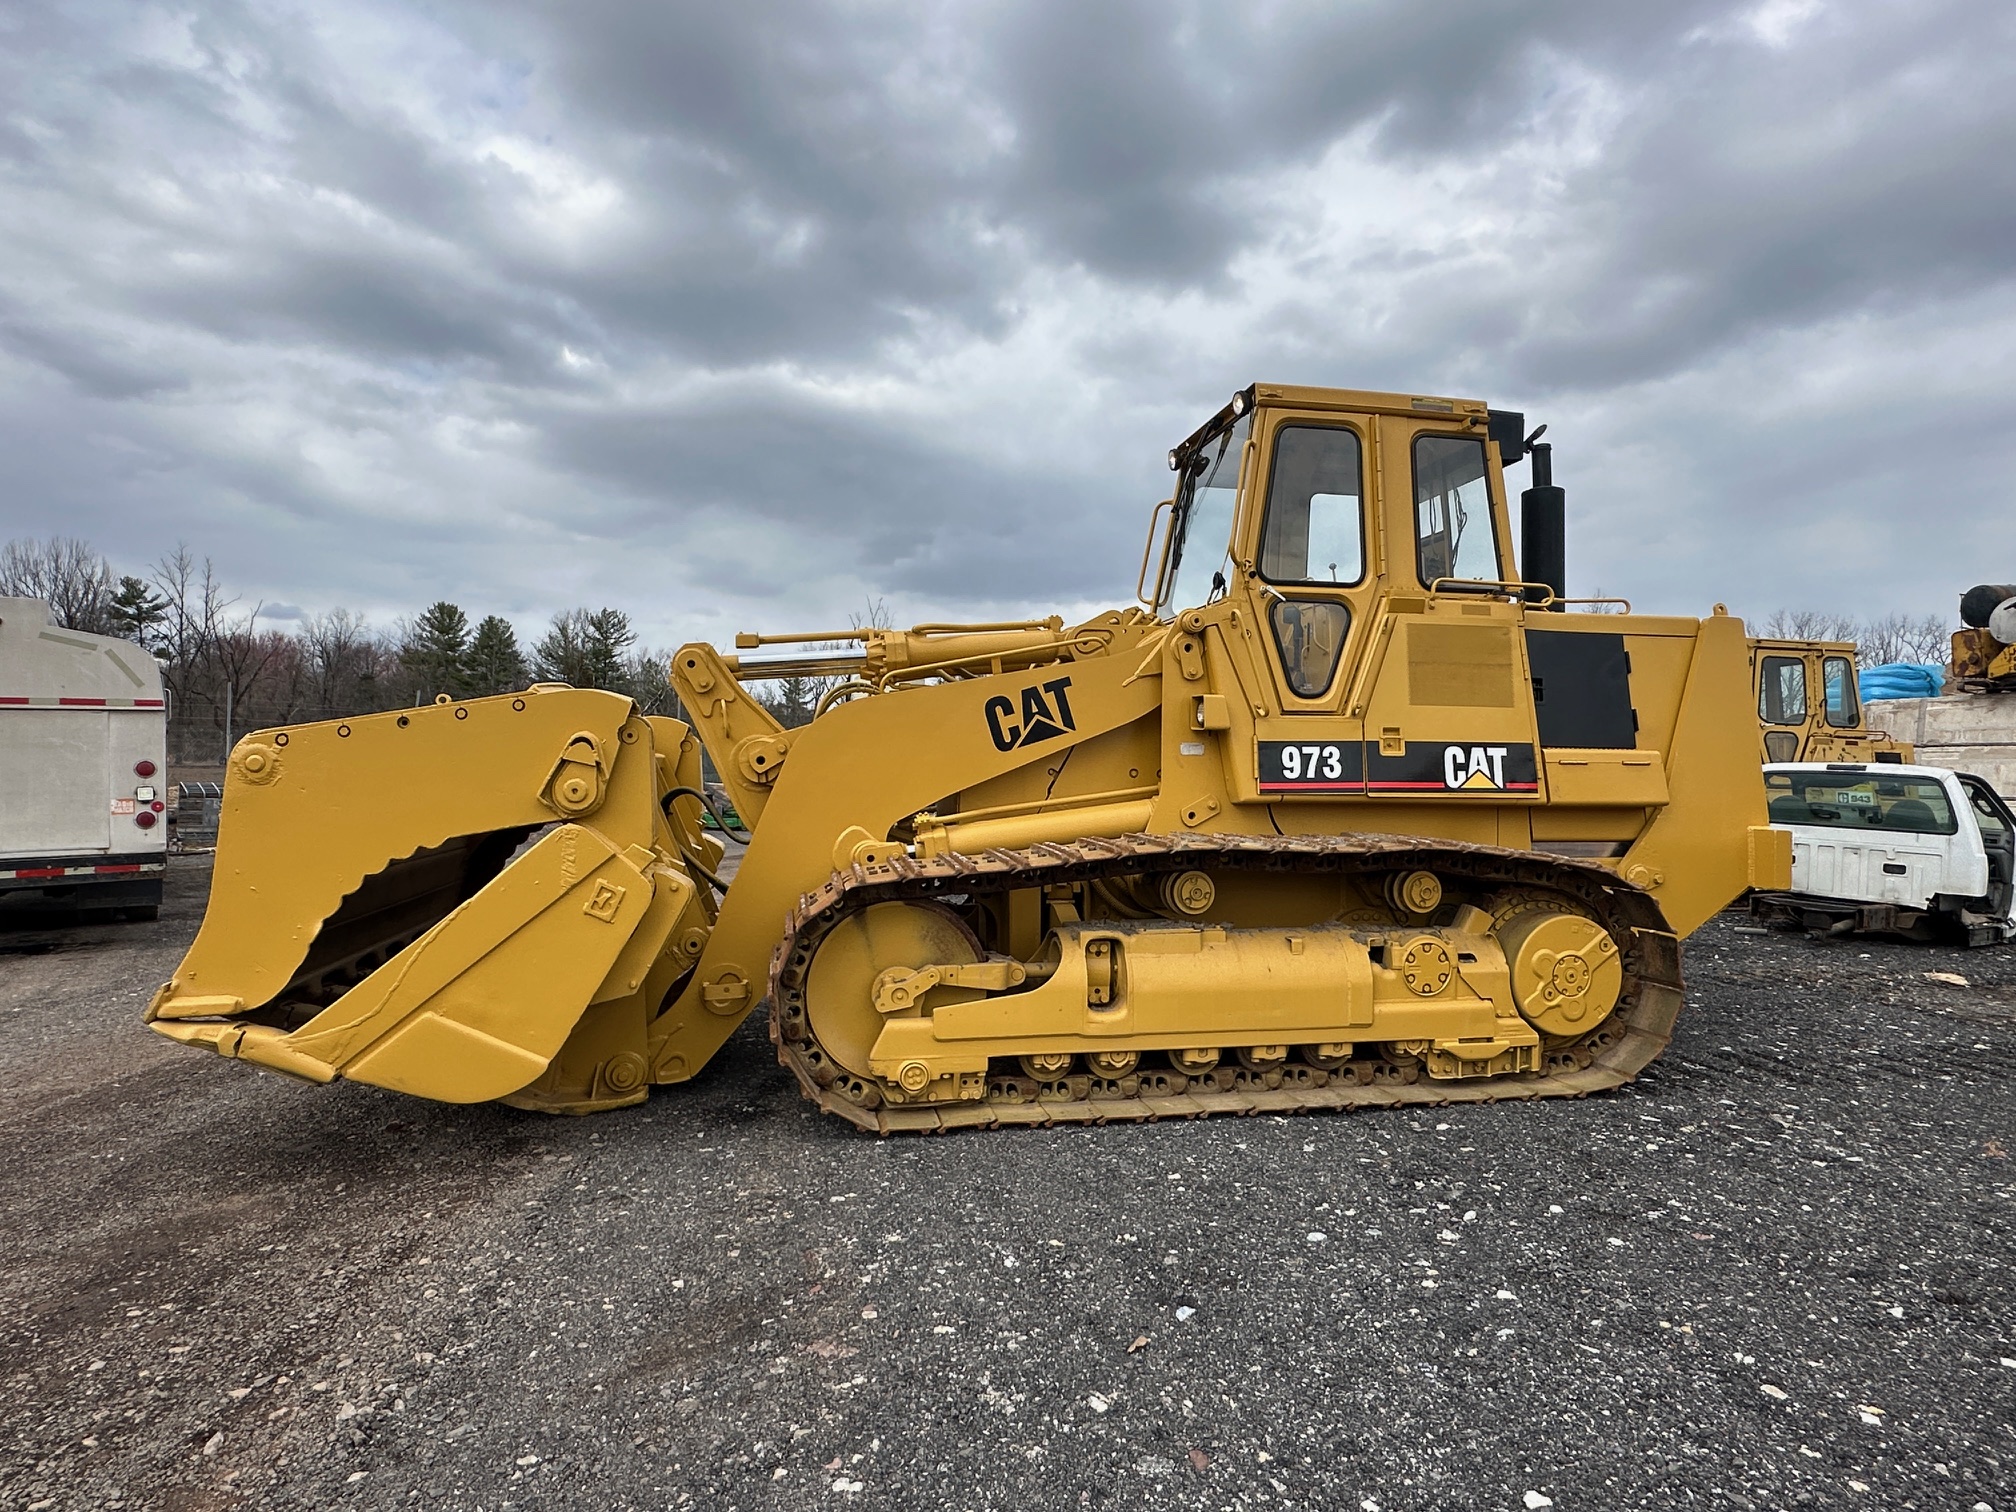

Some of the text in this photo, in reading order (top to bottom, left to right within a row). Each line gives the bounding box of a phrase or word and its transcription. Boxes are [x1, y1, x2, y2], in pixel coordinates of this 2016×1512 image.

[984, 676, 1076, 752] CAT
[1281, 745, 1342, 779] 973
[1444, 745, 1507, 789] CAT
[1850, 795, 1871, 803] 943
